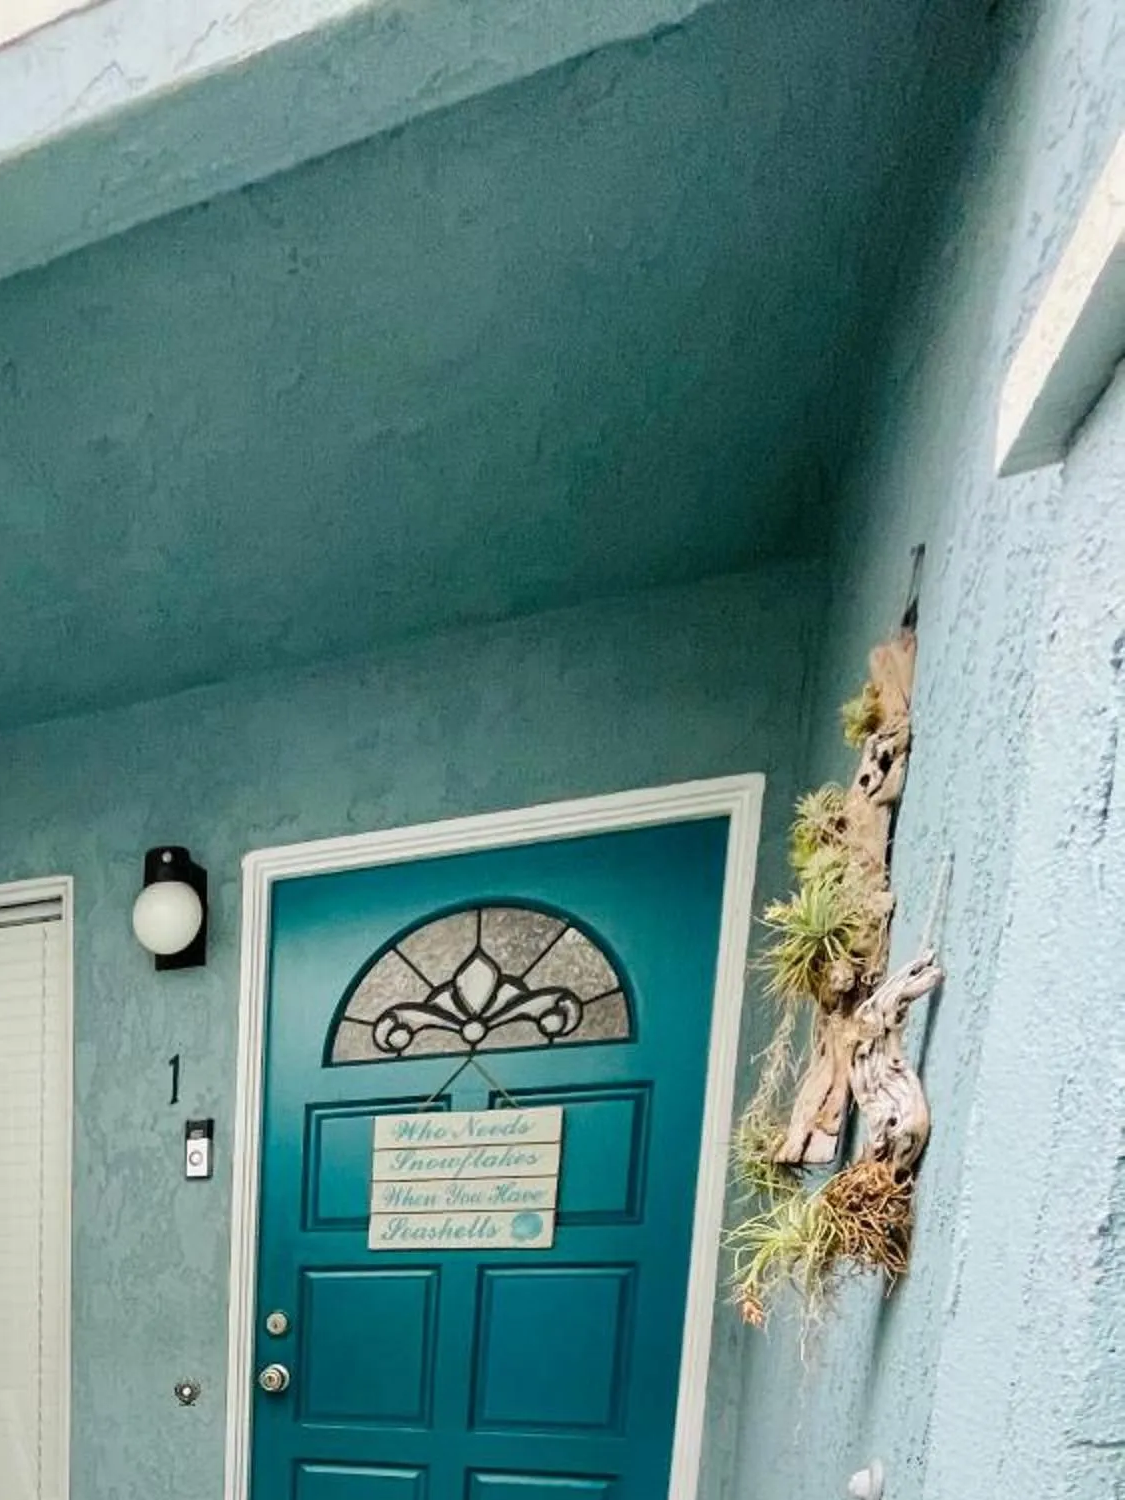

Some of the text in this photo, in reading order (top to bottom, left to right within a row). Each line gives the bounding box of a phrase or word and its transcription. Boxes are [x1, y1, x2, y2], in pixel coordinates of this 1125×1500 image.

[168, 1054, 180, 1105] 1
[393, 1114, 532, 1141] Who Needs
[390, 1147, 540, 1178] Snowflakes
[384, 1181, 545, 1206] When You Have
[381, 1215, 500, 1241] Seashells
